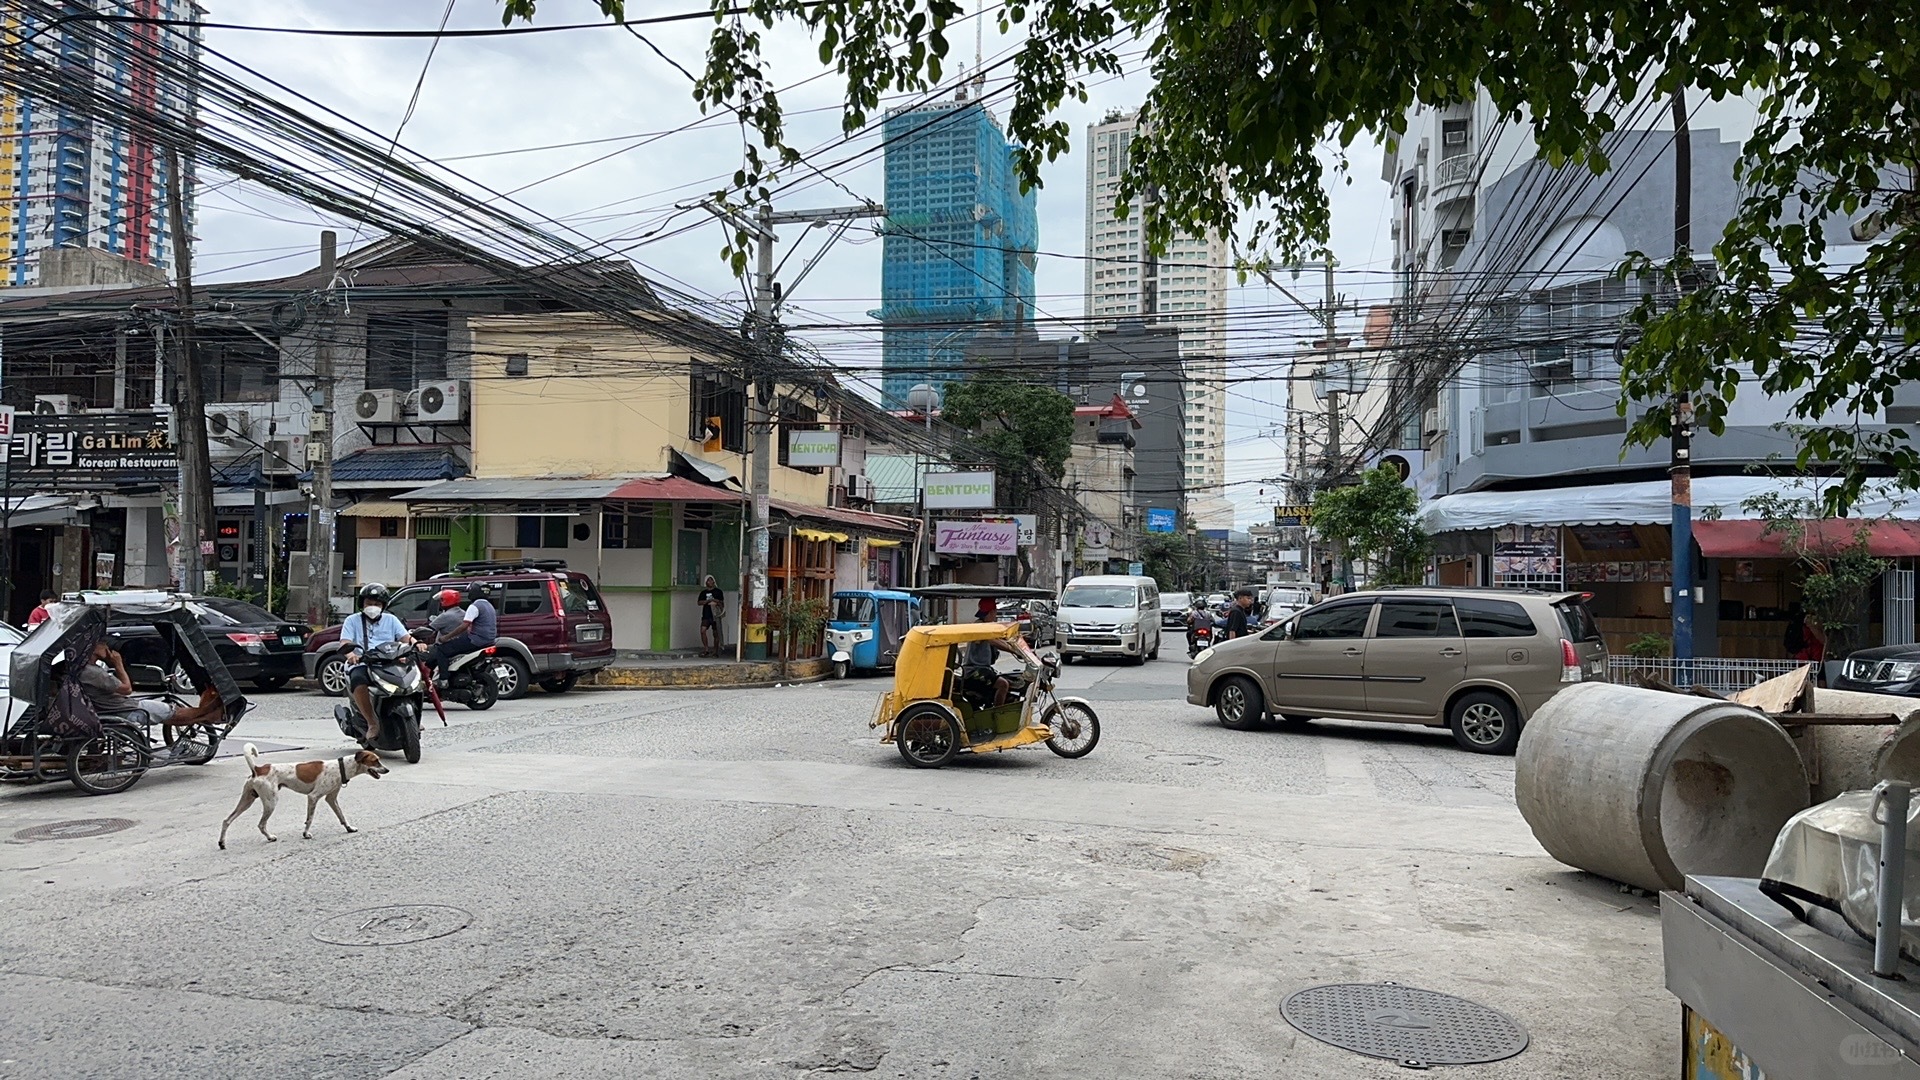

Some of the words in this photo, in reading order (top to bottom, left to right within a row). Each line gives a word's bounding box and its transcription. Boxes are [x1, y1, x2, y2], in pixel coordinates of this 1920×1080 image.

[82, 436, 106, 450] Ga
[111, 434, 142, 449] Lim
[791, 443, 836, 454] BENTOYA
[79, 458, 117, 468] Korean
[927, 484, 990, 496] BENTOYA
[1276, 506, 1313, 517] MASSA
[940, 528, 1013, 547] Fantasy
